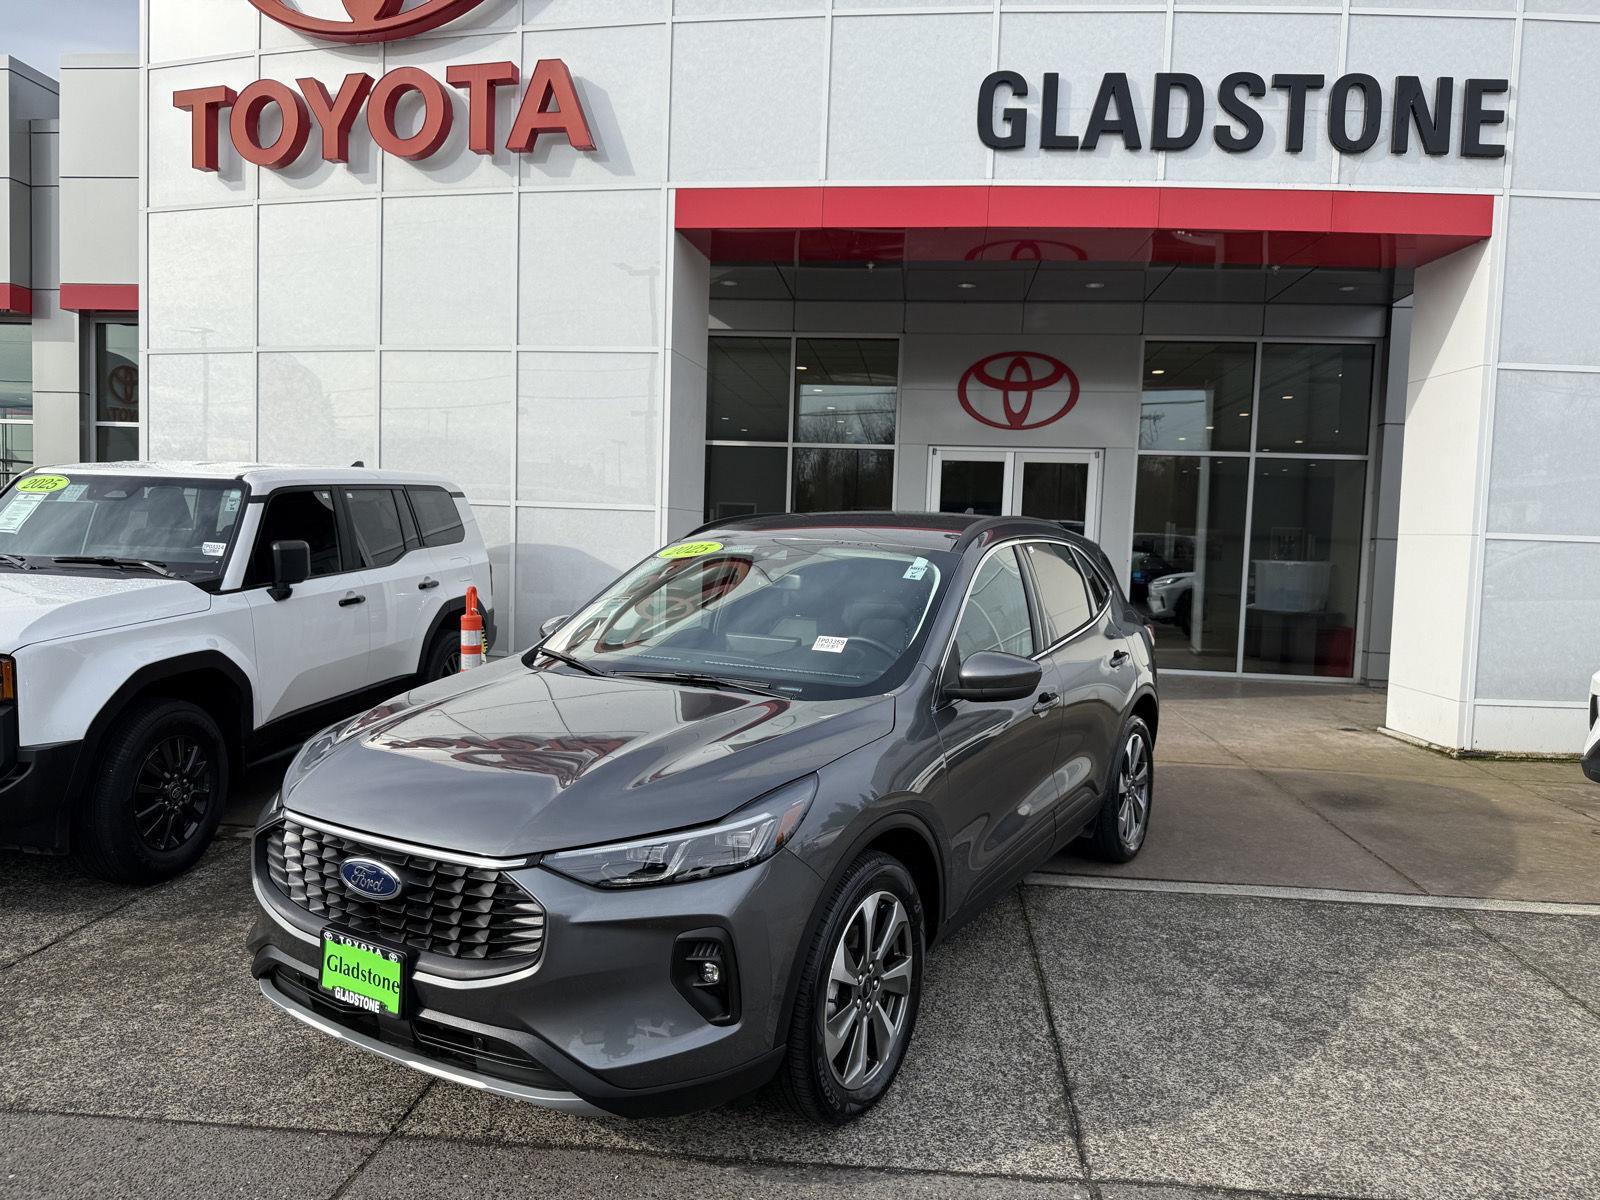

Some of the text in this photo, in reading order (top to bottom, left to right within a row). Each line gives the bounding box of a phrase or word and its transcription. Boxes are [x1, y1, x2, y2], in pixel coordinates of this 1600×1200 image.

[173, 59, 597, 172] TOYOTA
[977, 70, 1508, 157] GLADSTONE
[21, 478, 63, 489] 2025
[663, 543, 715, 556] 2025
[350, 865, 384, 893] Ford
[338, 935, 383, 957] TOYOTA
[326, 954, 400, 995] Gladstone
[334, 986, 381, 1014] GLADSTONE
